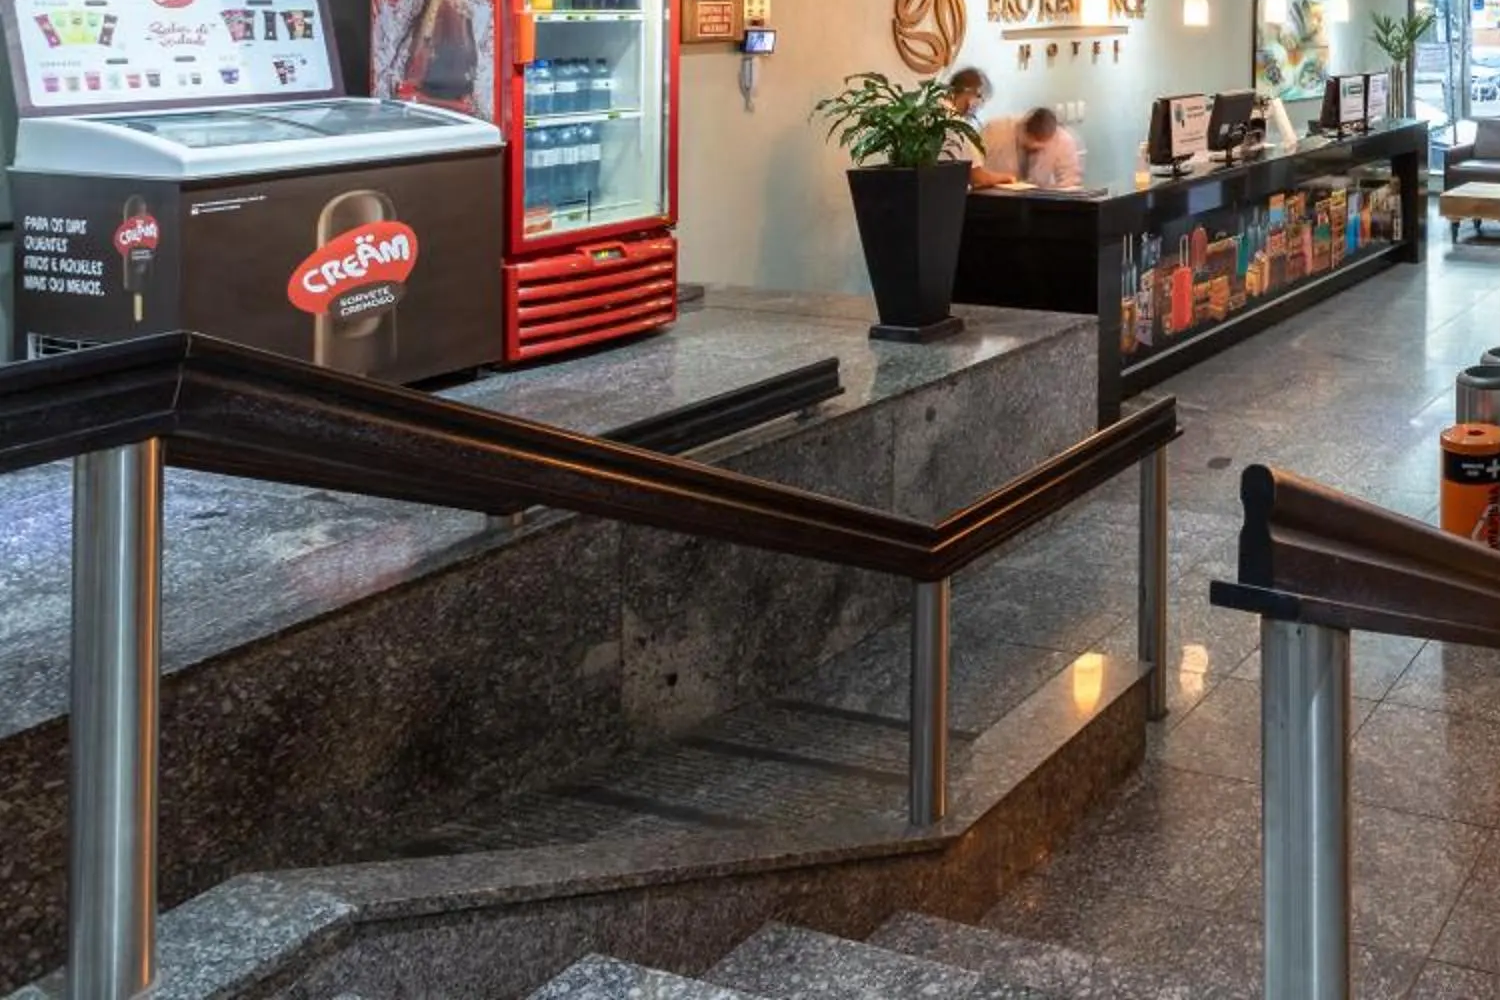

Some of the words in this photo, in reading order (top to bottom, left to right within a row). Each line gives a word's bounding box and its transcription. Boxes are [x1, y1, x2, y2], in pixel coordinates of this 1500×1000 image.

[303, 233, 410, 293] CREÄM
[340, 285, 391, 306] SORVETE
[341, 295, 395, 317] CREMOSO
